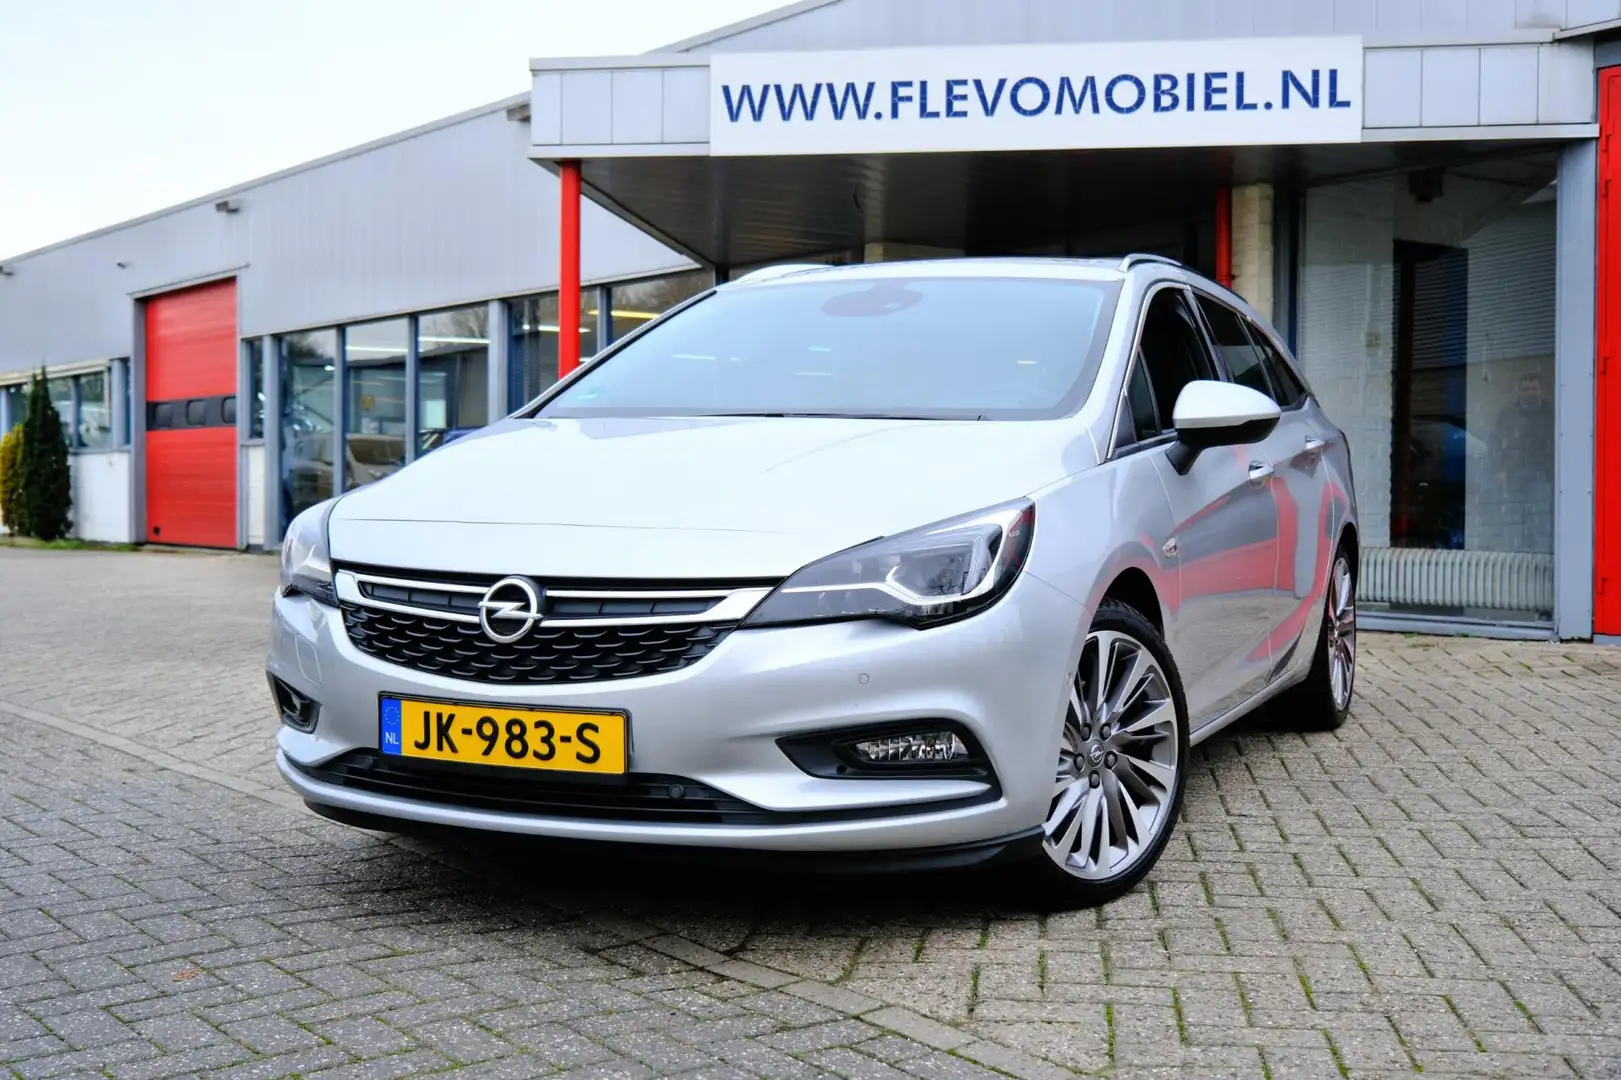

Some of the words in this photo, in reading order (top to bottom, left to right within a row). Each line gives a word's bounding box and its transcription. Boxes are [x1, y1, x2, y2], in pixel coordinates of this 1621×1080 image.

[721, 68, 1351, 122] WWW.FLEVOMOBIEL.NL
[385, 731, 399, 745] NL
[414, 711, 601, 764] JK-983-S
